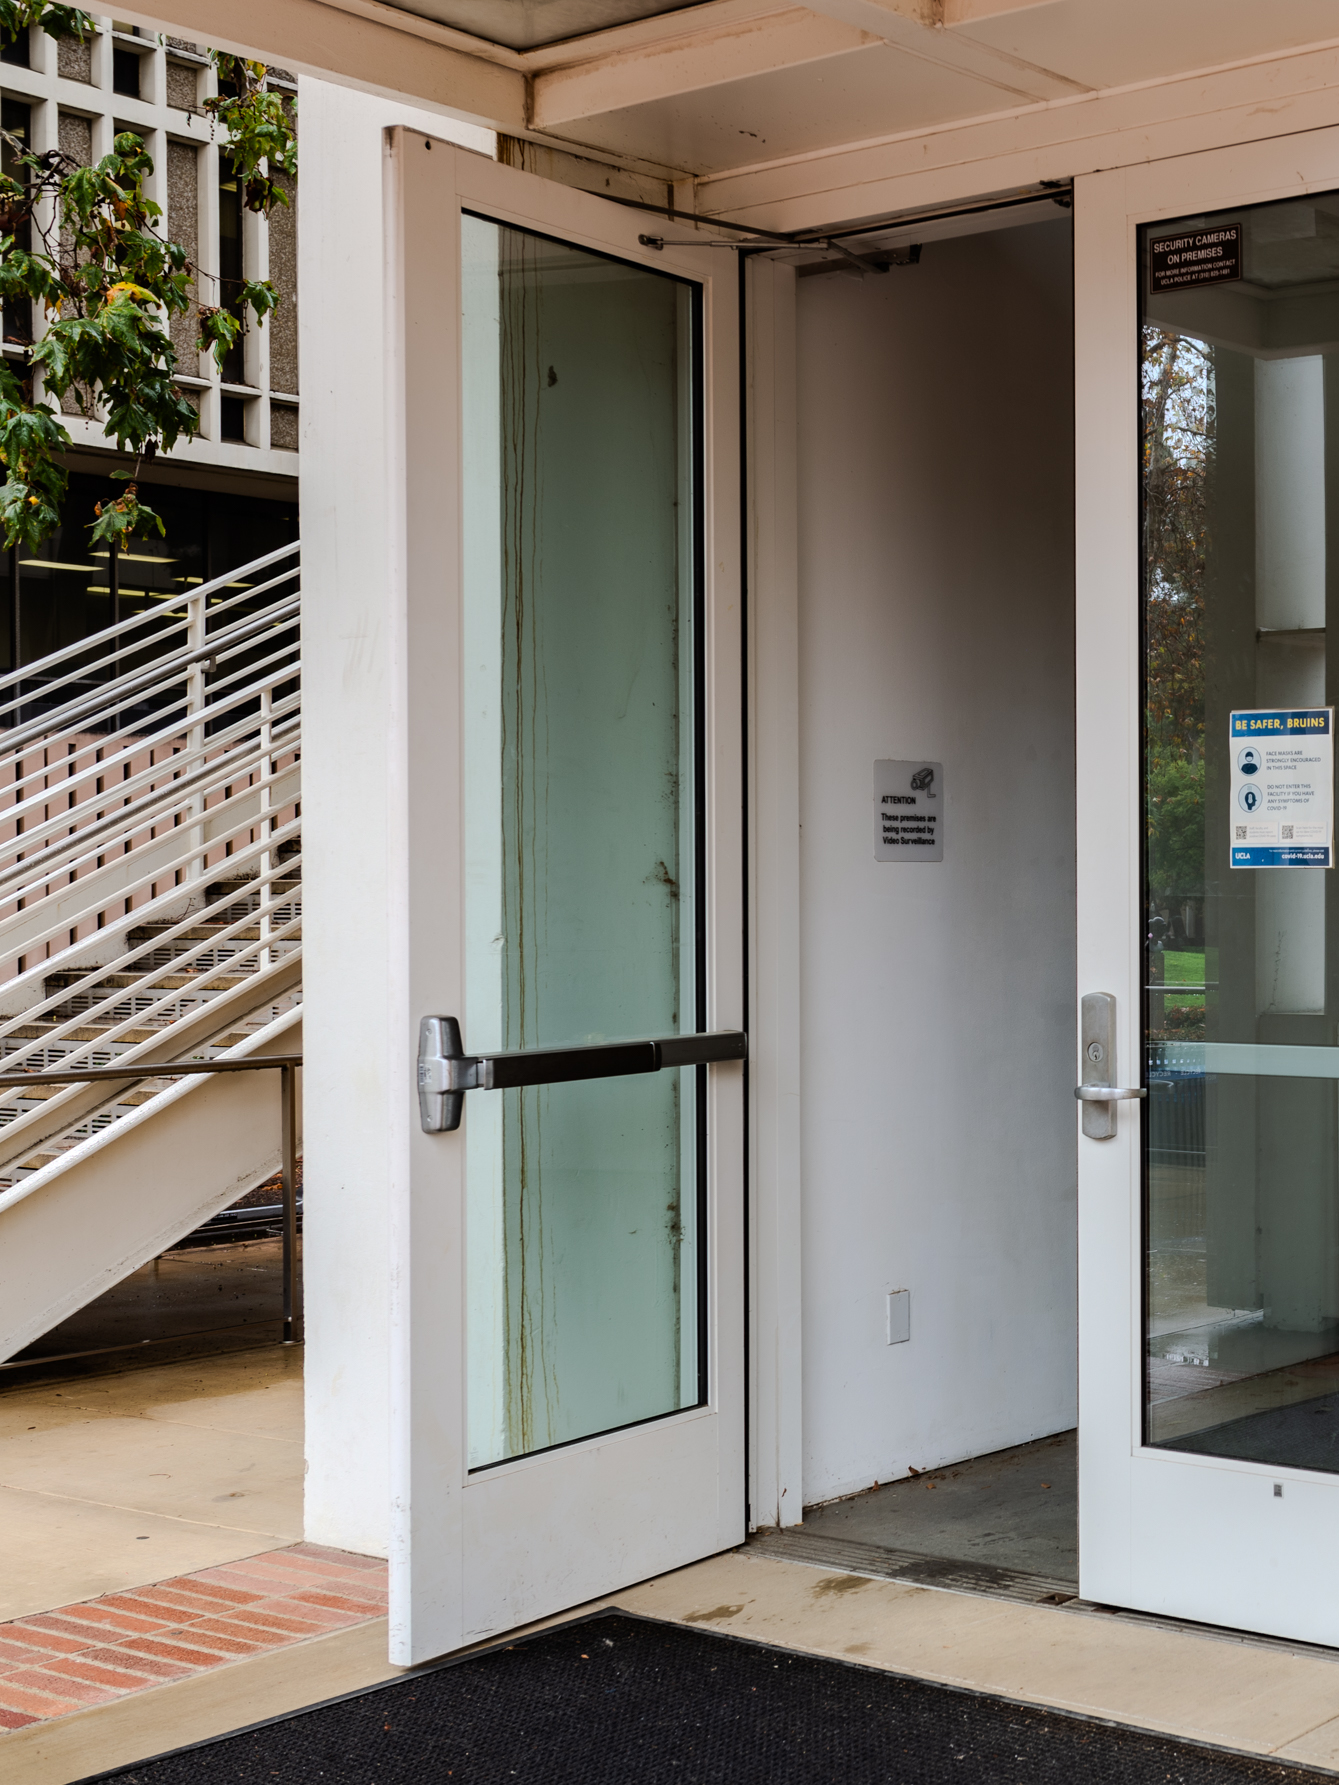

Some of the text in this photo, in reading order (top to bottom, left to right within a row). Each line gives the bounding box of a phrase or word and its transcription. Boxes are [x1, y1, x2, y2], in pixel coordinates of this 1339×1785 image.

[1154, 230, 1236, 253] SECURITY CAMERAS
[1168, 246, 1223, 264] ON PREMISES
[1180, 263, 1212, 273] INFORMATION
[1213, 259, 1235, 268] CONTACT
[1236, 718, 1325, 730] BE SAFER, BRUINS
[881, 796, 916, 804] ATTENTION
[881, 813, 899, 821] These
[900, 814, 926, 823] premises
[883, 825, 899, 835] being
[927, 826, 934, 835] by
[900, 836, 935, 845] Surveillance
